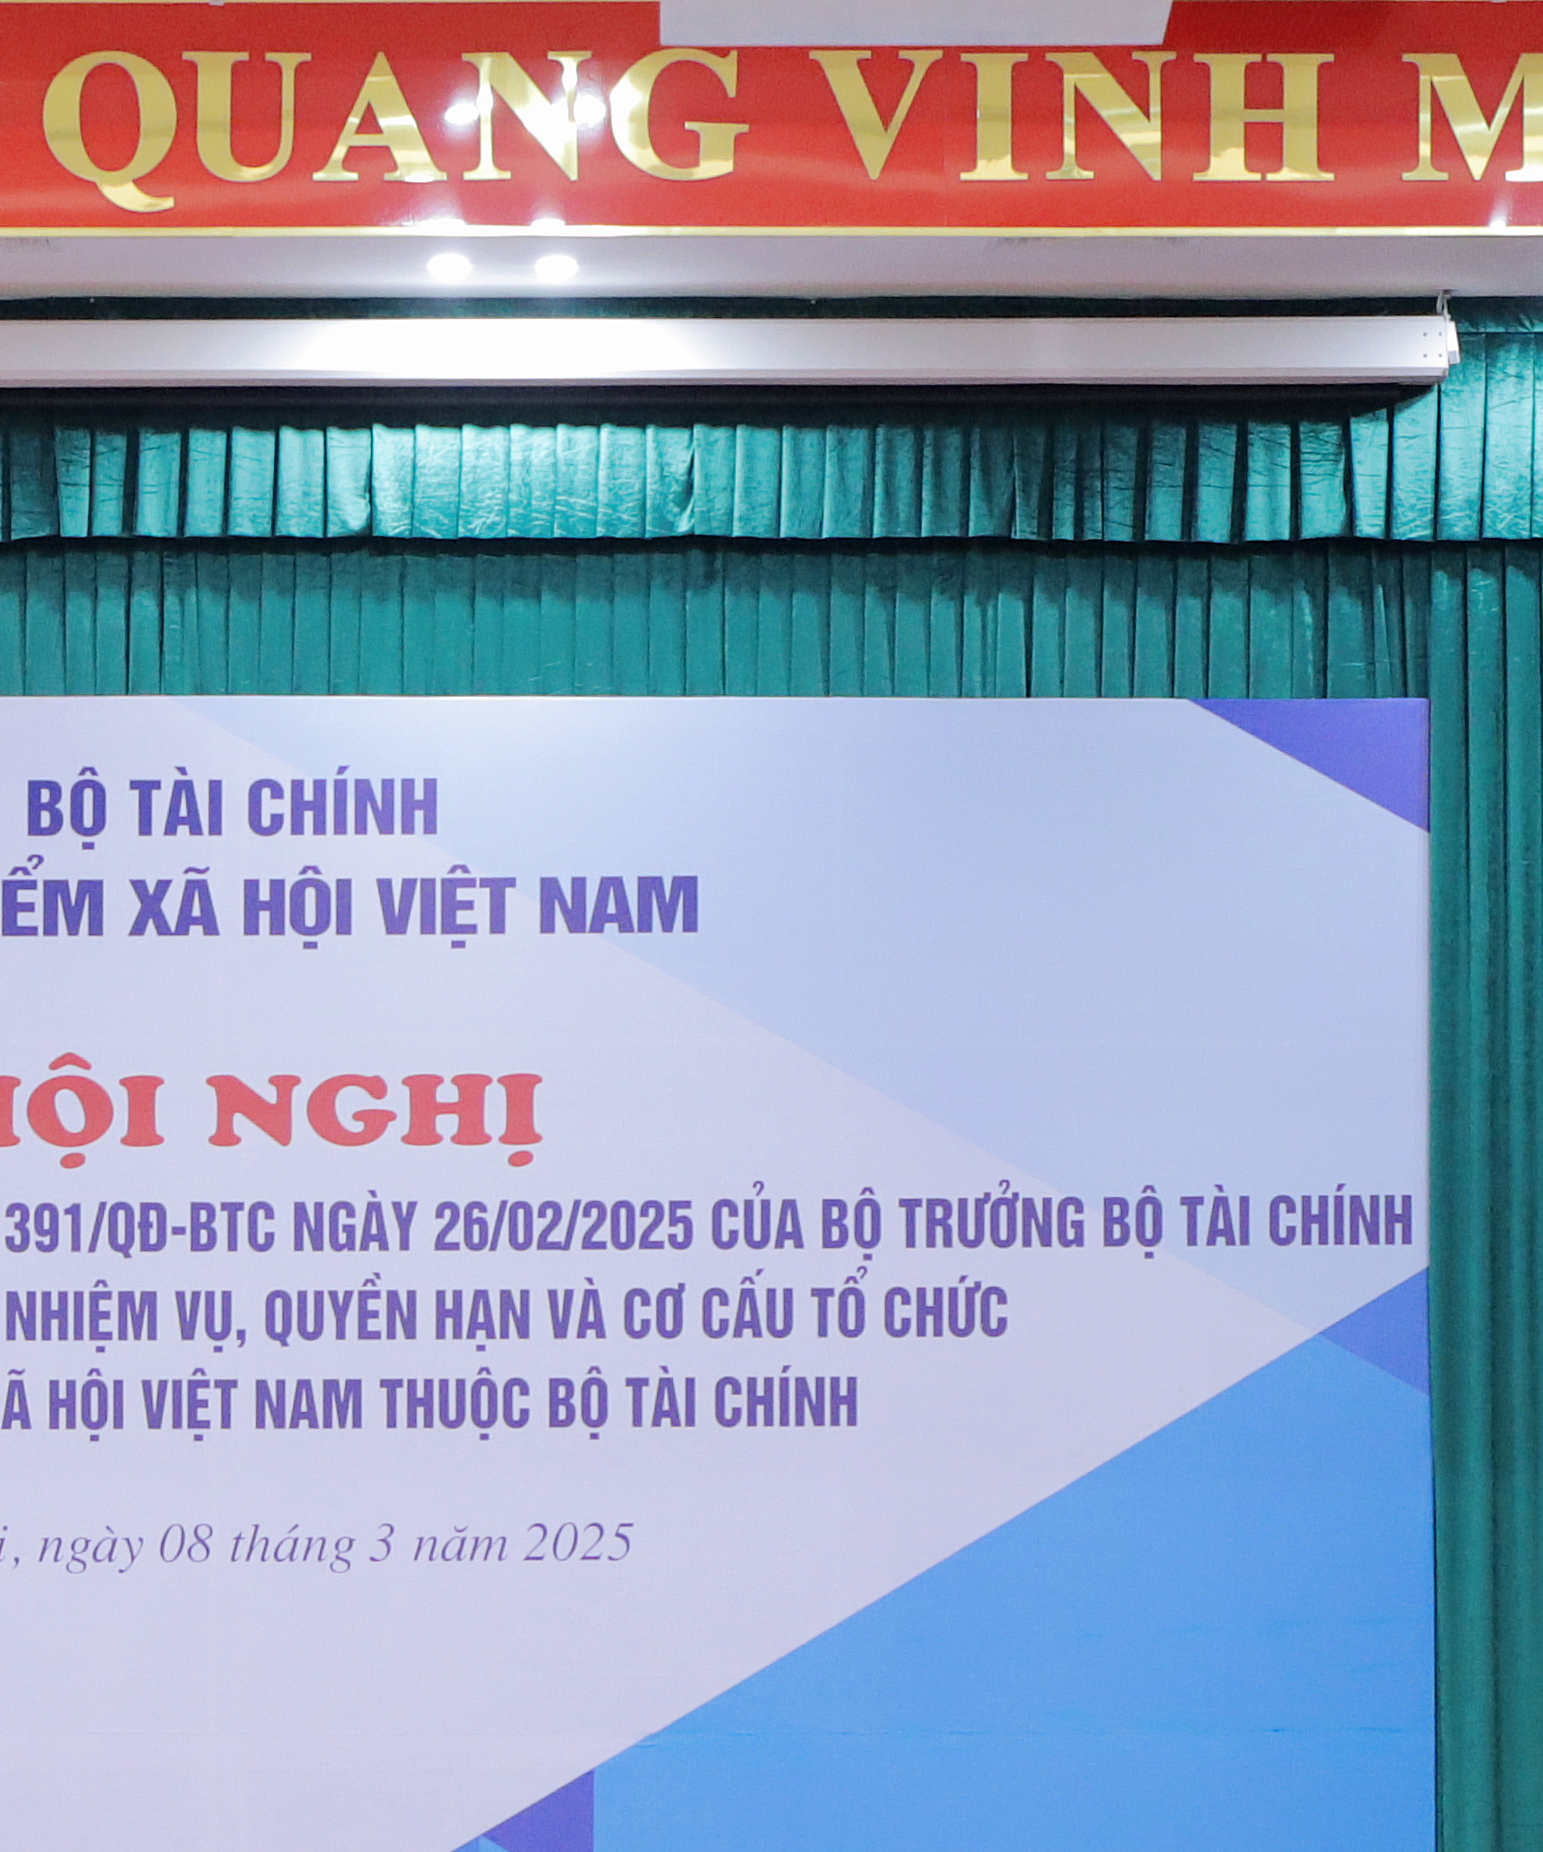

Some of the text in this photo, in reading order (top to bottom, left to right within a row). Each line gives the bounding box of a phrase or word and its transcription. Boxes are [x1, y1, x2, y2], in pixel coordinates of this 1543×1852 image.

[43, 48, 747, 214] QUANG
[809, 50, 1335, 183] VINH
[28, 766, 436, 848] BỘ TÀI CHÍNH
[129, 866, 219, 936] XÃ
[244, 866, 351, 949] HỘI
[377, 865, 516, 948] VIỆT
[540, 876, 697, 933] NAM
[208, 1074, 542, 1168] NGHỊ
[5, 1201, 274, 1258] 391/QĐ-BTC
[294, 1190, 417, 1252] NGÀY
[435, 1200, 693, 1251] 26/02/2025
[712, 1181, 804, 1250] CỦA
[822, 1187, 881, 1261] BỘ
[899, 1180, 1084, 1248] TRƯỞNG
[1103, 1185, 1163, 1259] BỘ
[1180, 1184, 1250, 1246] TÀI
[1269, 1183, 1412, 1246] CHÍNH
[6, 1280, 157, 1353] NHIỆM
[175, 1291, 245, 1352] VỤ,
[266, 1274, 416, 1347] QUYỀN
[436, 1290, 529, 1351] HẠN
[548, 1277, 606, 1339] VÀ
[624, 1283, 685, 1339] CƠ
[702, 1271, 793, 1339] CẤU
[811, 1265, 865, 1338] TỔ
[885, 1274, 1007, 1338] CHỨC
[49, 1368, 123, 1441] HỘI
[142, 1368, 238, 1441] VIỆT
[256, 1379, 362, 1429] NAM
[380, 1367, 529, 1440] THUỘC
[549, 1366, 608, 1440] BỘ
[626, 1366, 695, 1427] TÀI
[715, 1365, 857, 1427] CHÍNH
[38, 1525, 144, 1574] ngày
[159, 1523, 214, 1563] 08
[230, 1523, 356, 1574] tháng
[368, 1523, 395, 1563] 3
[413, 1526, 507, 1562] năm
[523, 1522, 634, 1562] 2025
